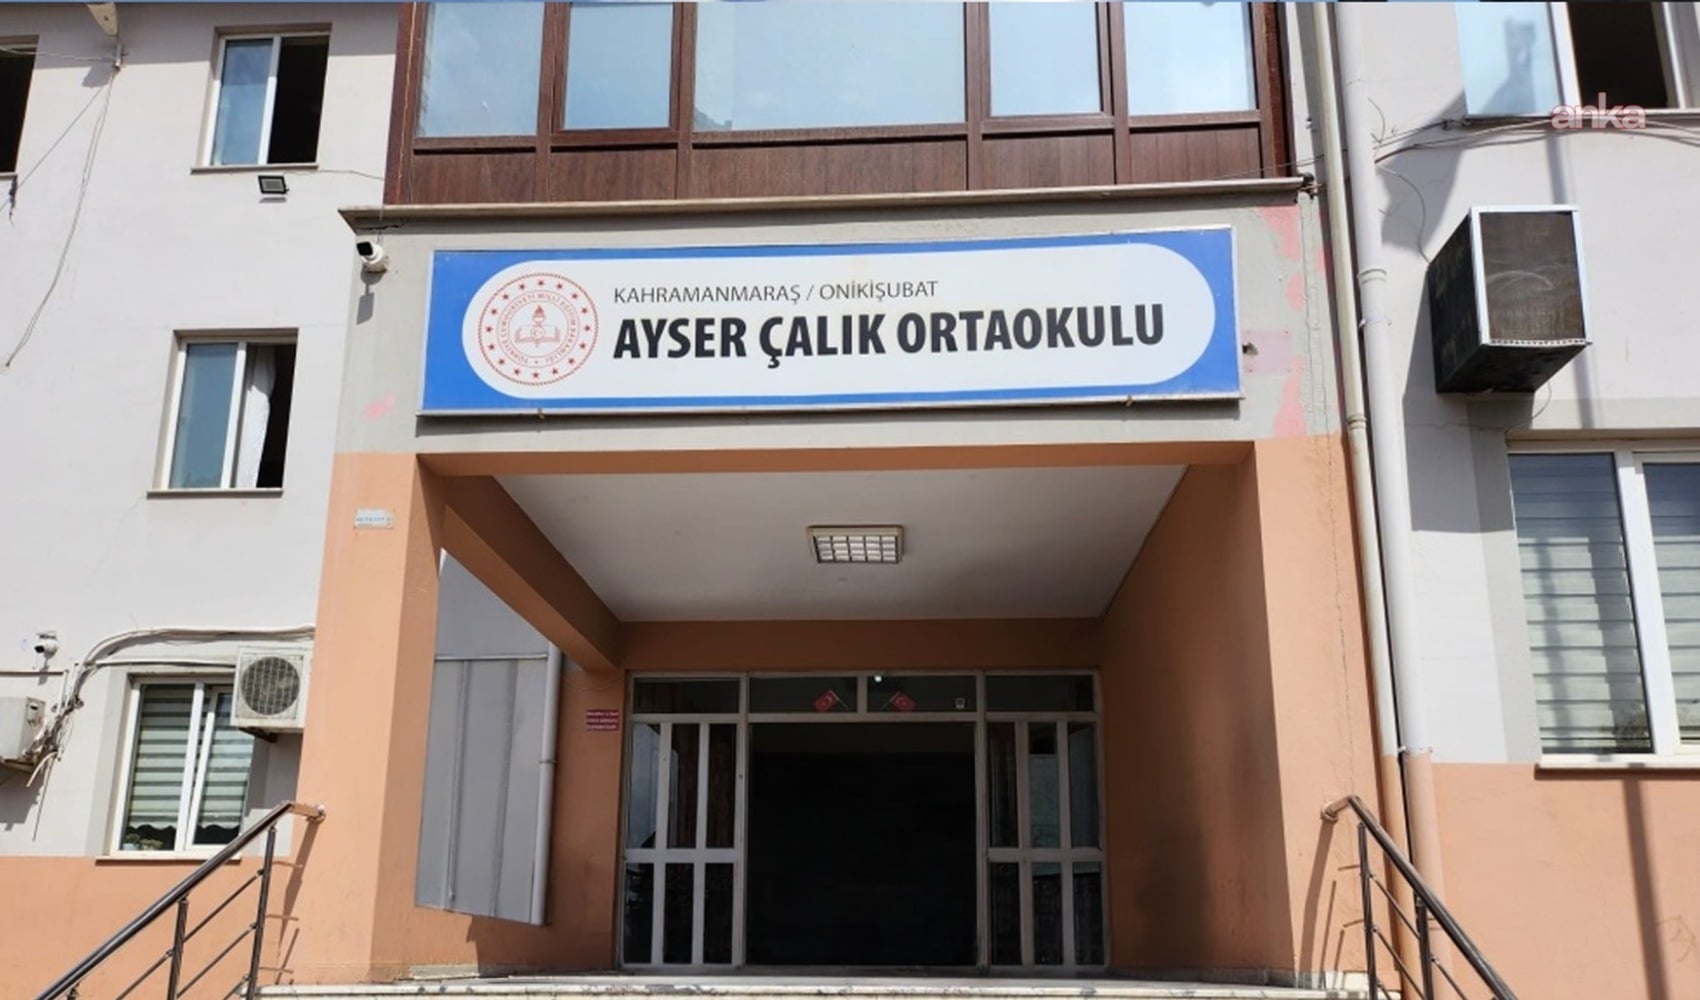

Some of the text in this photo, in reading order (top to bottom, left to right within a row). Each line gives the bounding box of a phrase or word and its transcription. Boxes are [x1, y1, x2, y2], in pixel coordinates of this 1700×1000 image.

[613, 280, 937, 305] KAHRAMANMARAŞ / ONİKİŞUBAT
[612, 303, 1164, 369] AYSER ÇALIK ORTAOKULU
